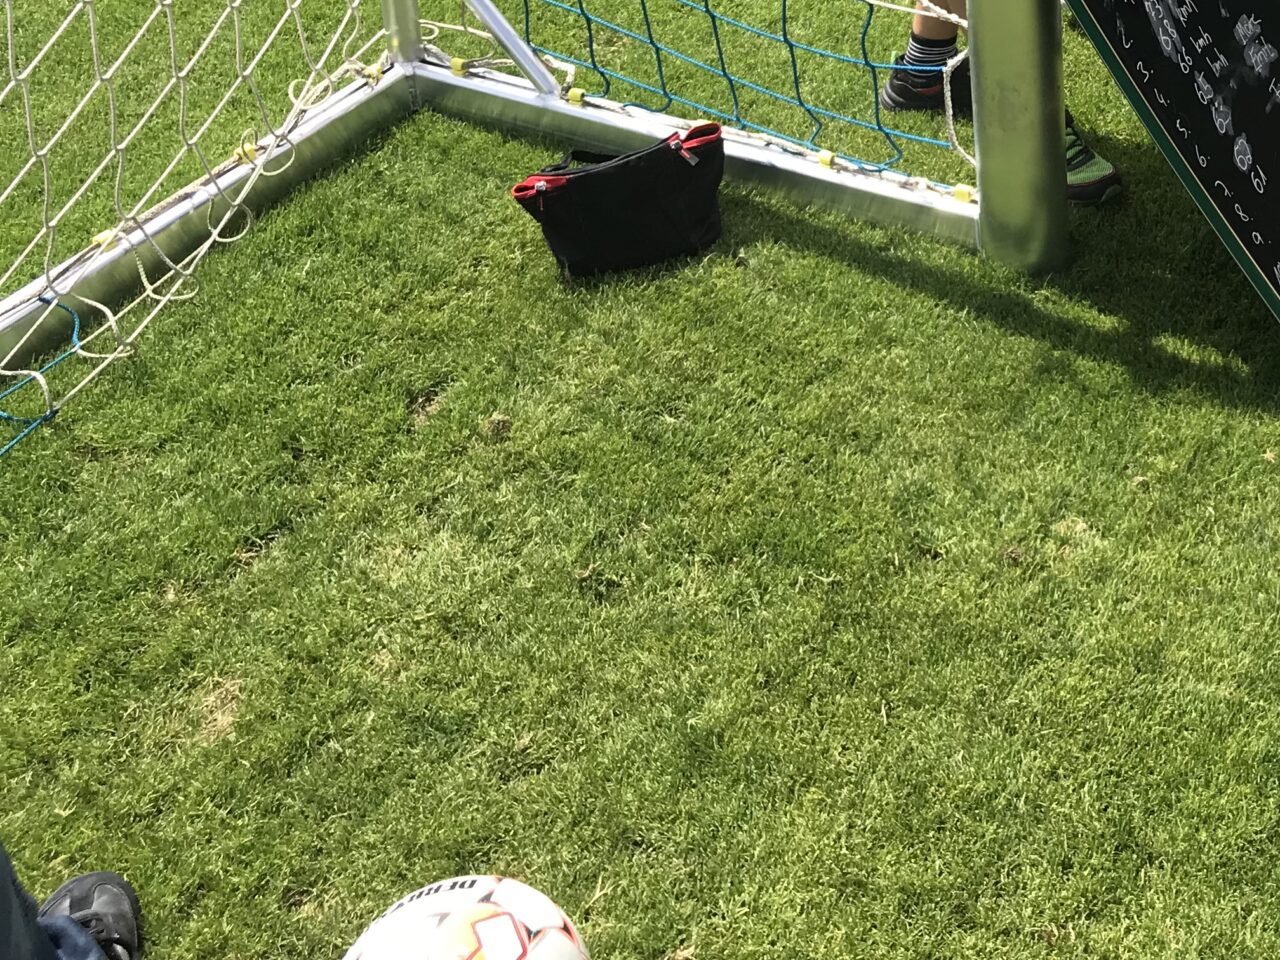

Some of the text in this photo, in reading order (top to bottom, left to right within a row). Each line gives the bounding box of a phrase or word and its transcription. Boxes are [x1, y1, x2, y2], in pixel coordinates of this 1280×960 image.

[1159, 19, 1177, 50] 68
[1178, 46, 1192, 74] 66
[1190, 26, 1212, 54] kmh
[1194, 71, 1214, 104] 65
[1251, 164, 1267, 194] 61
